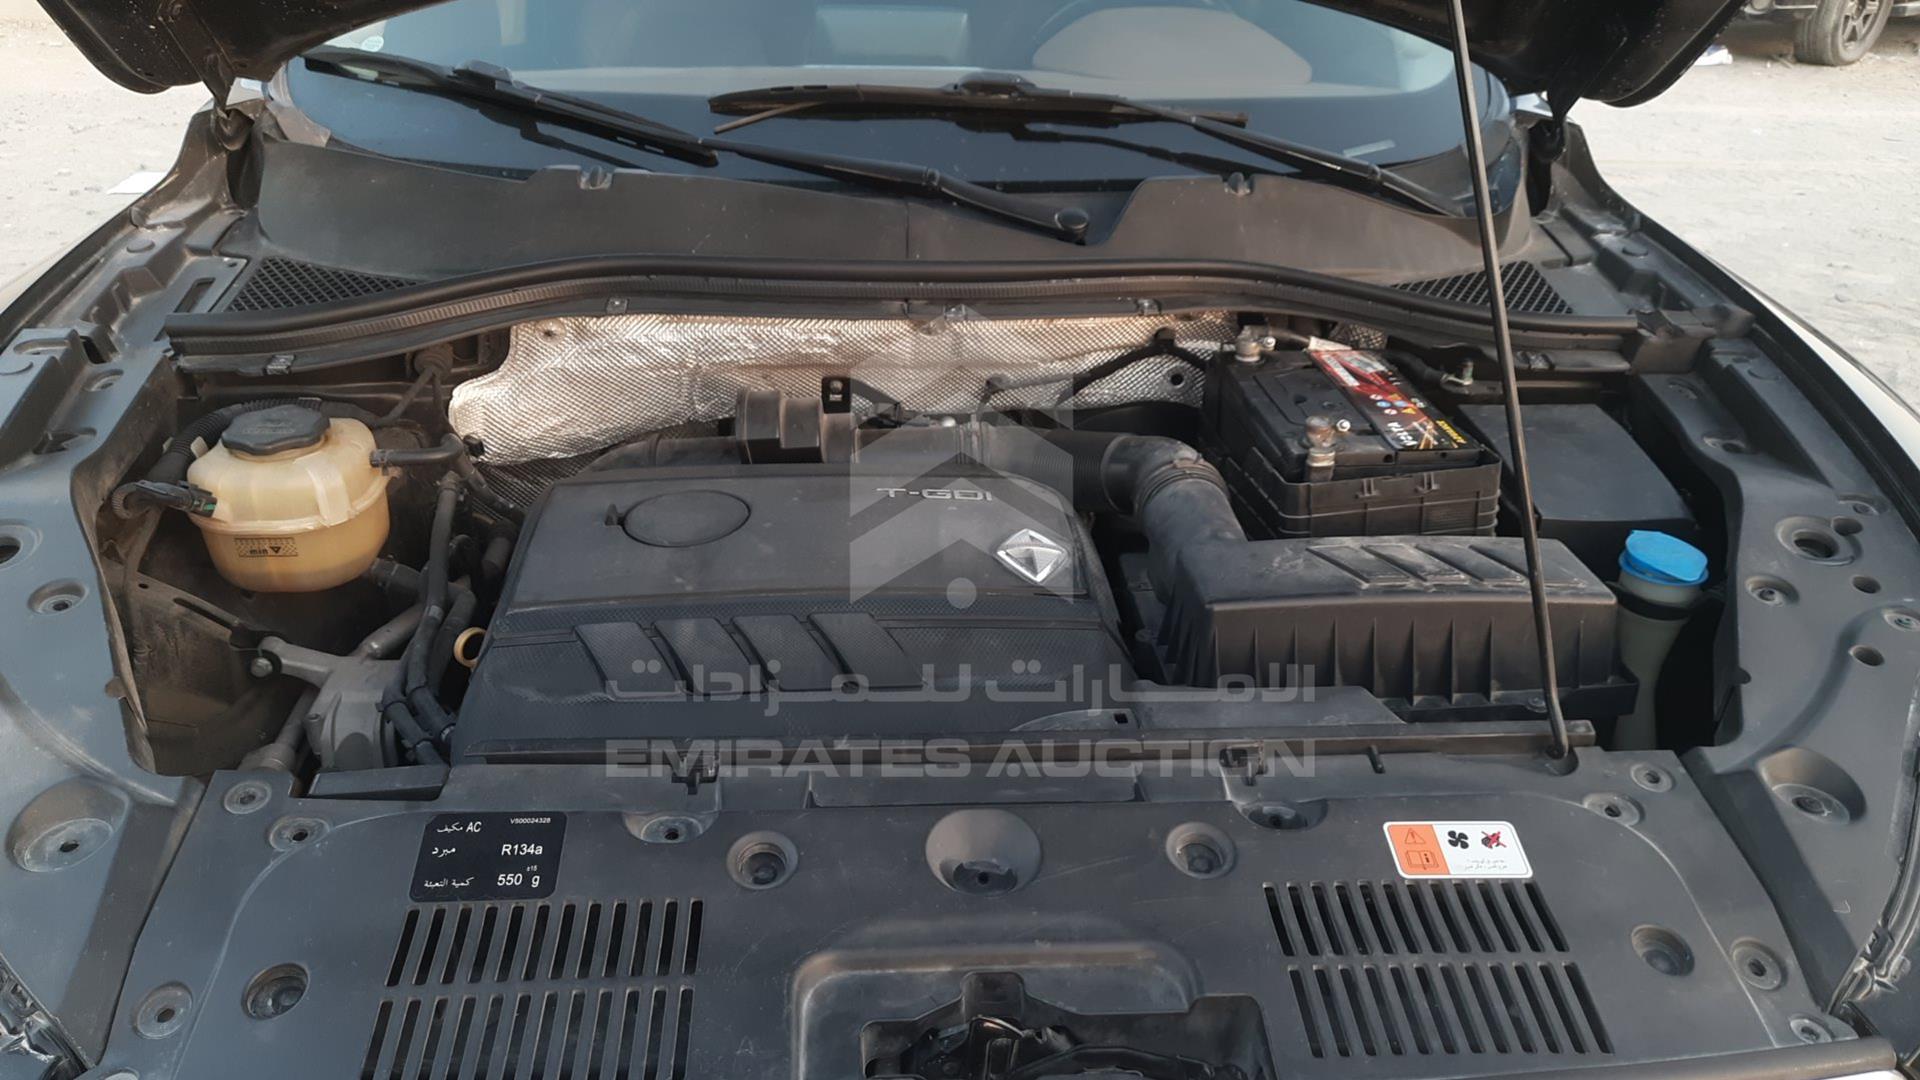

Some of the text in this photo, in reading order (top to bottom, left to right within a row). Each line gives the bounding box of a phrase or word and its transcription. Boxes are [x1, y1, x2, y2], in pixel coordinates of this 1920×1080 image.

[876, 488, 993, 501] T-GDI
[437, 821, 482, 833] AC مكيف
[432, 847, 456, 858] مبرد
[501, 843, 543, 856] R134a
[451, 877, 474, 888] كمية
[497, 873, 540, 888] 550 g
